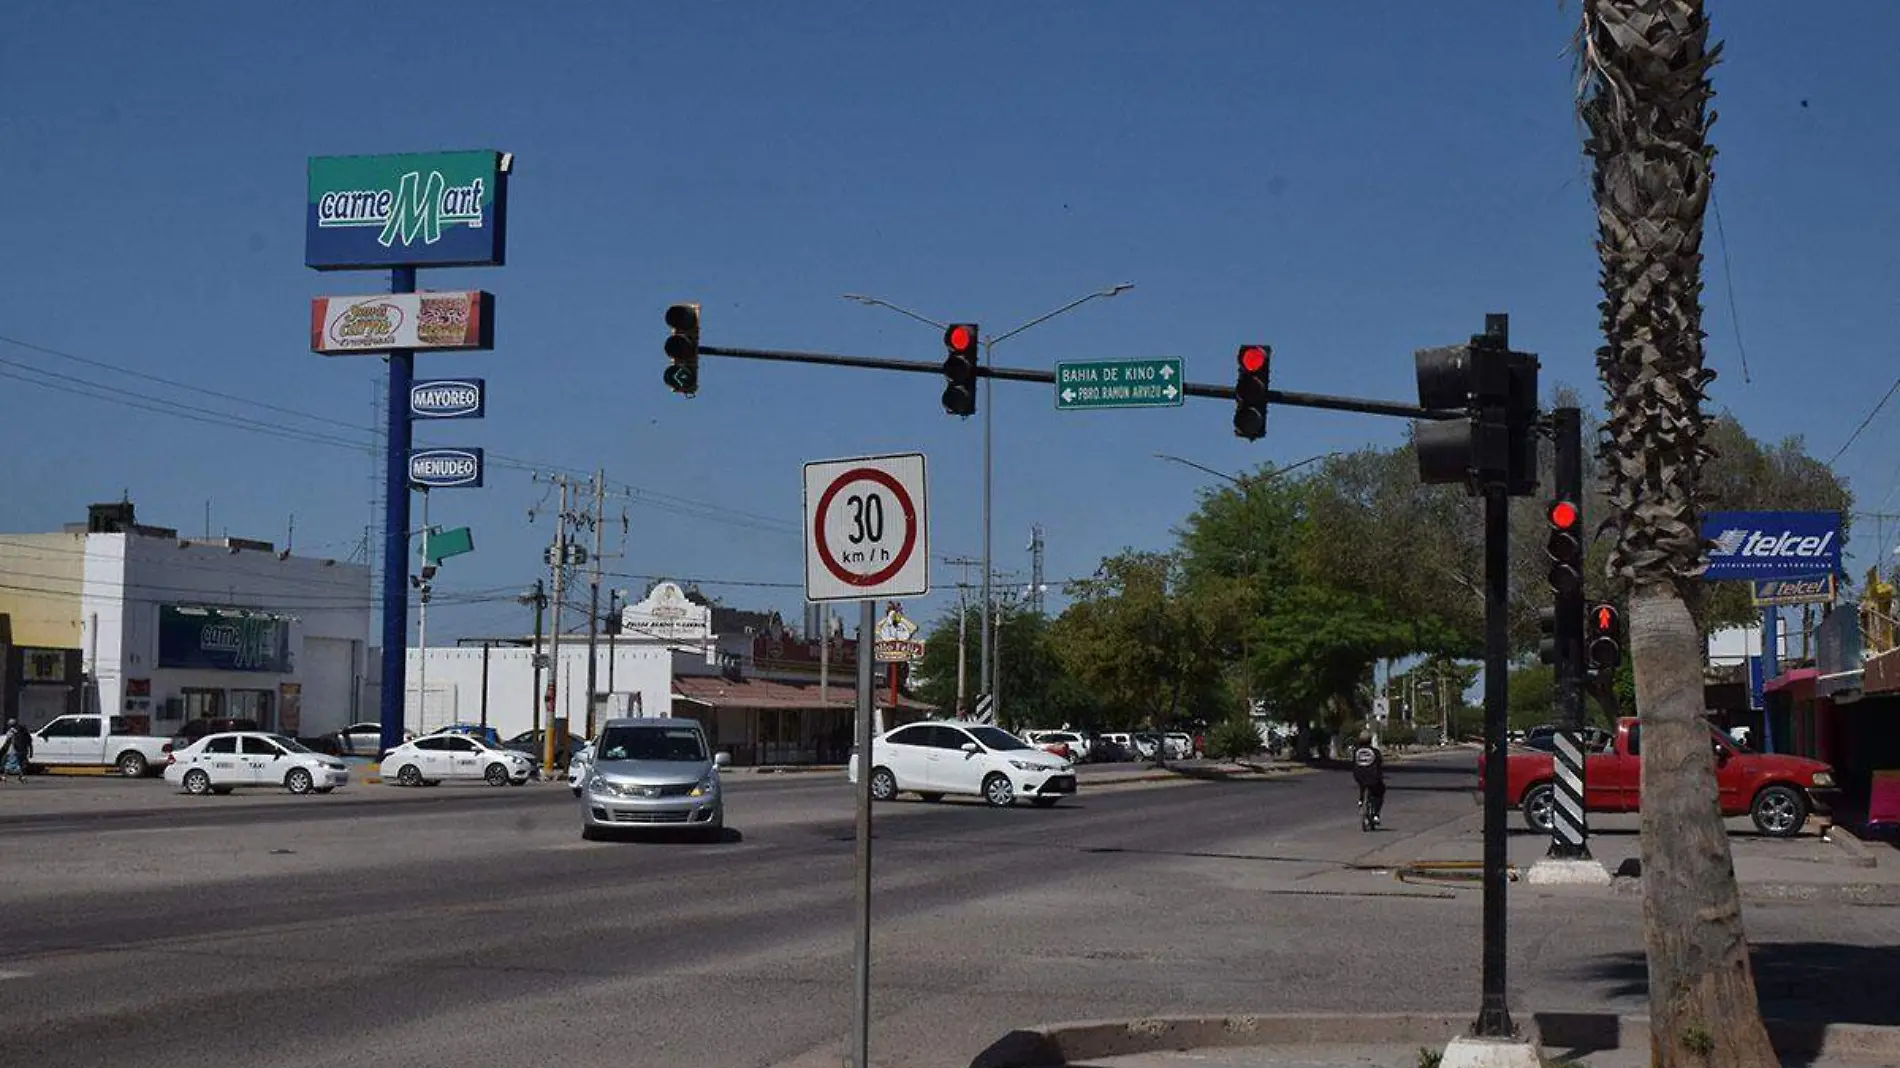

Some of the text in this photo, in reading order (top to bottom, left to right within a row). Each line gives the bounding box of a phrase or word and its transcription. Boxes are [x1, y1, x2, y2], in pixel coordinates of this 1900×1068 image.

[1062, 366, 1155, 382] BAHIA DE KINO
[414, 389, 476, 407] MAYOREO
[413, 459, 473, 476] MENUDEO
[847, 493, 883, 544] 30
[1742, 530, 1834, 556] telcel
